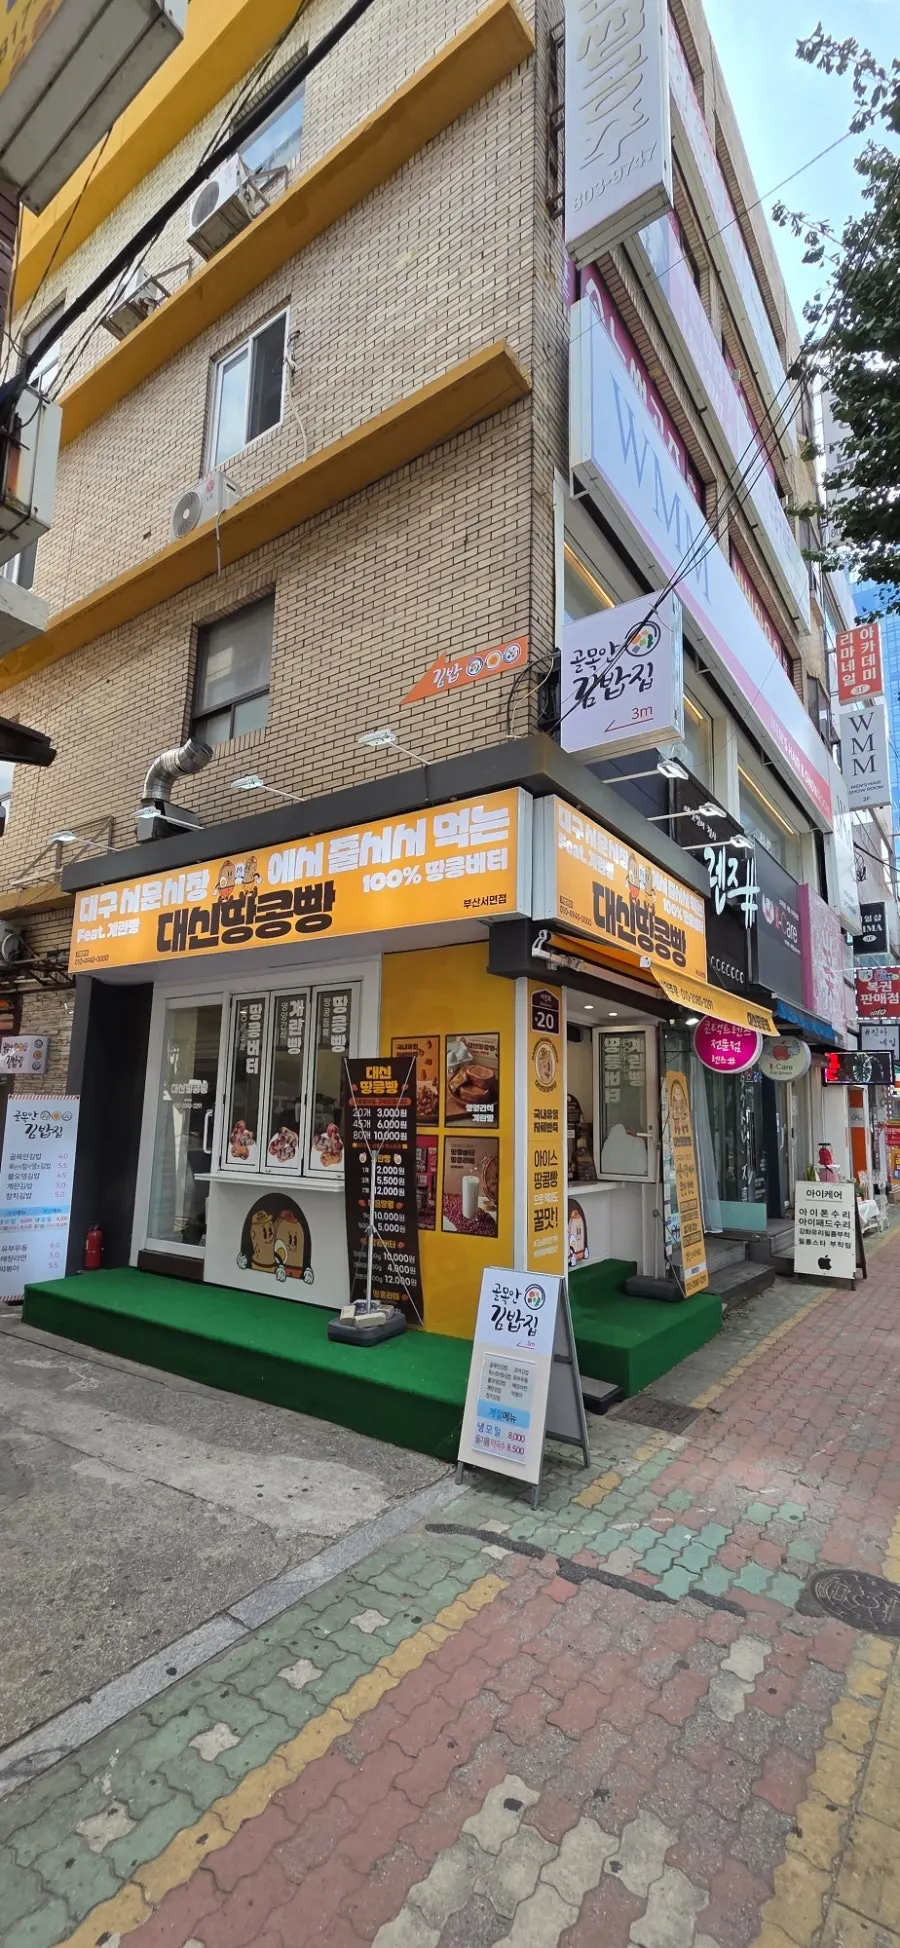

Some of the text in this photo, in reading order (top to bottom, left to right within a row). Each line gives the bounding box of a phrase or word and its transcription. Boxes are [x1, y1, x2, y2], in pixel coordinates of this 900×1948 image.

[572, 142, 658, 213] 803-9747
[608, 370, 712, 606] WMM
[569, 640, 621, 674] 골목안
[839, 633, 856, 687] 리마네일
[859, 626, 877, 681] 아카데미
[432, 665, 464, 688] 김밥
[573, 661, 655, 710] 김밥집
[631, 706, 654, 720] 3m
[848, 711, 877, 777] WMM
[866, 784, 884, 793] ROOM
[557, 804, 585, 841] 대구
[585, 823, 630, 870] 서문시장
[557, 834, 588, 863] Feat.
[79, 804, 511, 923] 대구 서문시장 에서 줄서서 먹는
[362, 847, 508, 893] 100% 땅콩버터
[463, 893, 507, 910] 부산서면점
[156, 880, 336, 953] 대신땅콩빵
[662, 898, 684, 921] 100%
[76, 917, 140, 944] Feat. 계란빵
[592, 880, 687, 969] 대신땅콩빵
[867, 981, 892, 993] 복권
[861, 992, 899, 1005] 판매점
[287, 1000, 304, 1055] 계란빵
[331, 995, 348, 1053] 땅콩빵
[537, 1011, 555, 1030] 20
[704, 1021, 752, 1037] 콘택트렌즈
[245, 1003, 263, 1075] 땅콩버터
[711, 1038, 742, 1053] 전문점
[365, 1065, 392, 1080] 대신
[171, 1080, 209, 1094] 대신땅콩빵
[360, 1080, 399, 1095] 땅콩빵
[352, 1108, 408, 1119] 20개 3,000원
[465, 1103, 494, 1113] 영양간식
[13, 1109, 38, 1124] 골목안
[472, 1113, 494, 1123] 계란빵
[24, 1123, 64, 1139] 김밥집
[352, 1120, 408, 1131] 45개 6,000원
[373, 1131, 408, 1142] 10,000원
[9, 1152, 42, 1161] 골목안김밥
[534, 1150, 558, 1168] 아이스
[376, 1166, 406, 1176] 2,000원
[6, 1182, 33, 1190] 계란김밥
[376, 1177, 406, 1187] 5,500원
[534, 1170, 558, 1190] 땅콩빵
[5, 1192, 33, 1201] 참치김밥
[374, 1187, 406, 1197] 12,000원
[806, 1189, 843, 1200] 아이케어
[373, 1211, 406, 1222] 10,000원
[534, 1206, 559, 1232] 꿀맛!
[798, 1208, 851, 1219] 아이폰수리
[377, 1223, 406, 1234] 5,000원
[798, 1218, 851, 1229] 아이패드수리
[799, 1228, 850, 1239] 강화유리필름부착
[2, 1244, 28, 1252] 유부우동
[383, 1252, 416, 1264] 10,000원
[384, 1274, 417, 1287] 12,000원
[491, 1283, 522, 1305] 골목안
[490, 1304, 539, 1338] 김밥집
[526, 1339, 536, 1348] 3m
[507, 1431, 526, 1444] 8,000
[506, 1443, 525, 1456] 8,500
